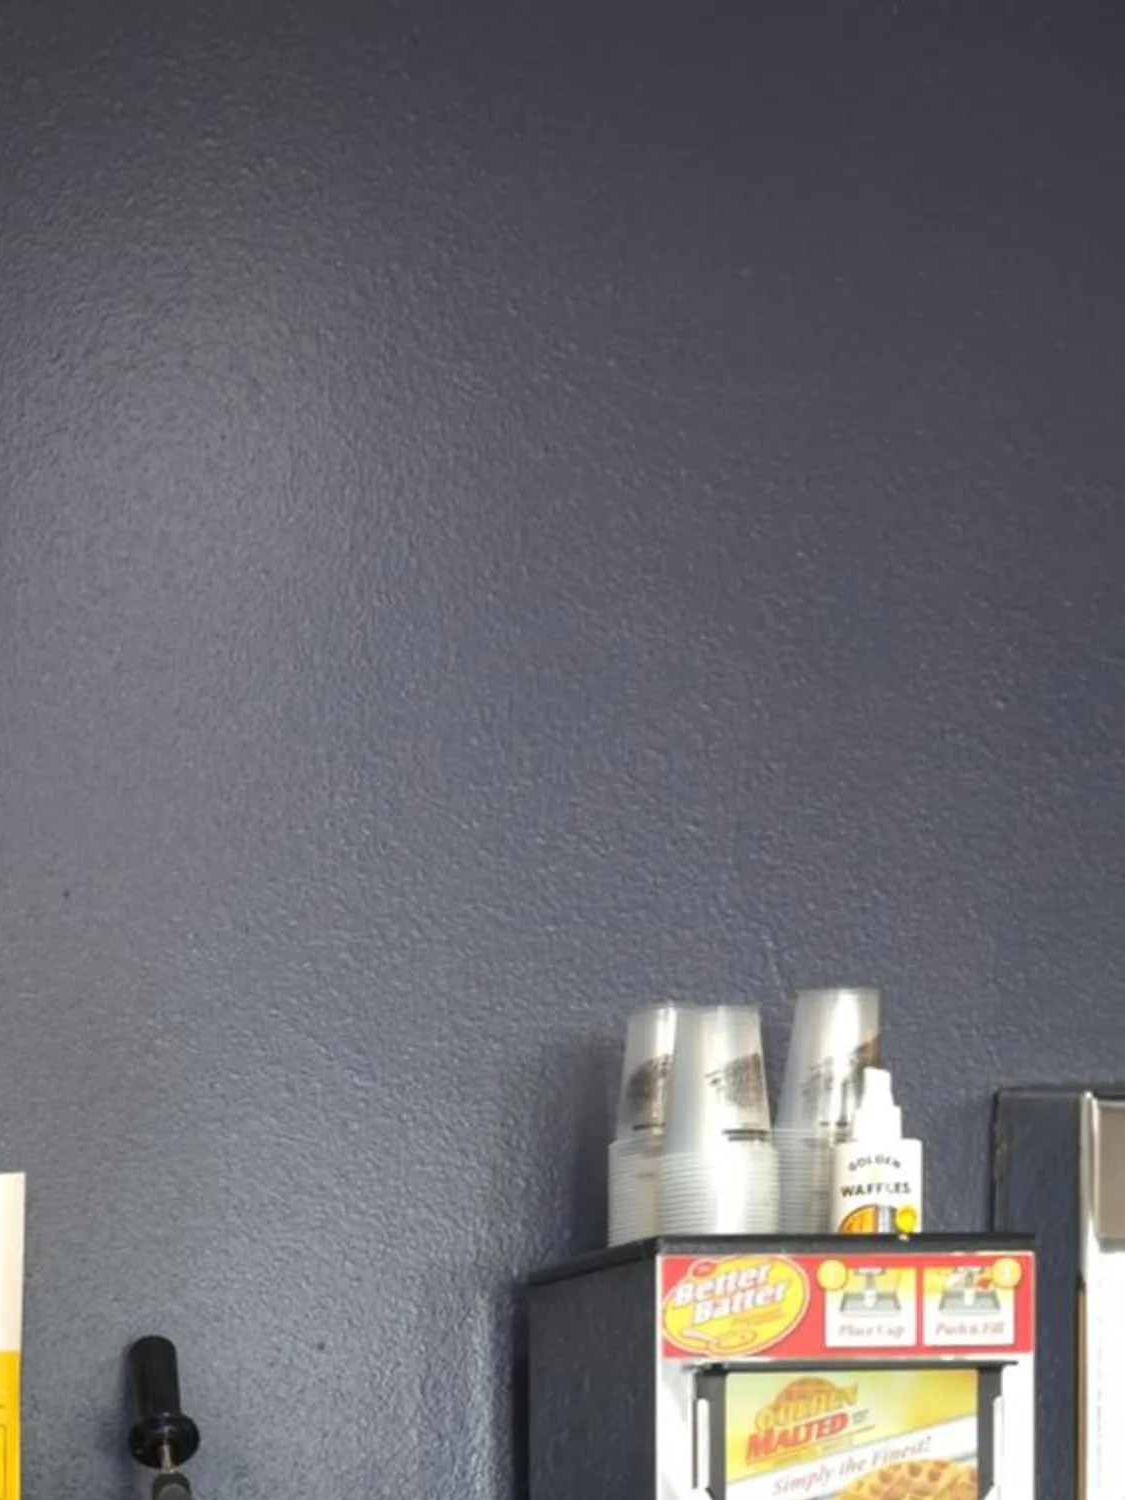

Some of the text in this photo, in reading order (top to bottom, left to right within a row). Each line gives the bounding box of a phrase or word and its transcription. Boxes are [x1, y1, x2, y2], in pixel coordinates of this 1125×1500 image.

[840, 1181, 911, 1198] WAFFLES
[672, 1262, 773, 1307] Better
[693, 1278, 789, 1324] Batter
[747, 1412, 849, 1465] MALTED
[772, 1464, 834, 1496] Simply
[839, 1456, 867, 1476] the
